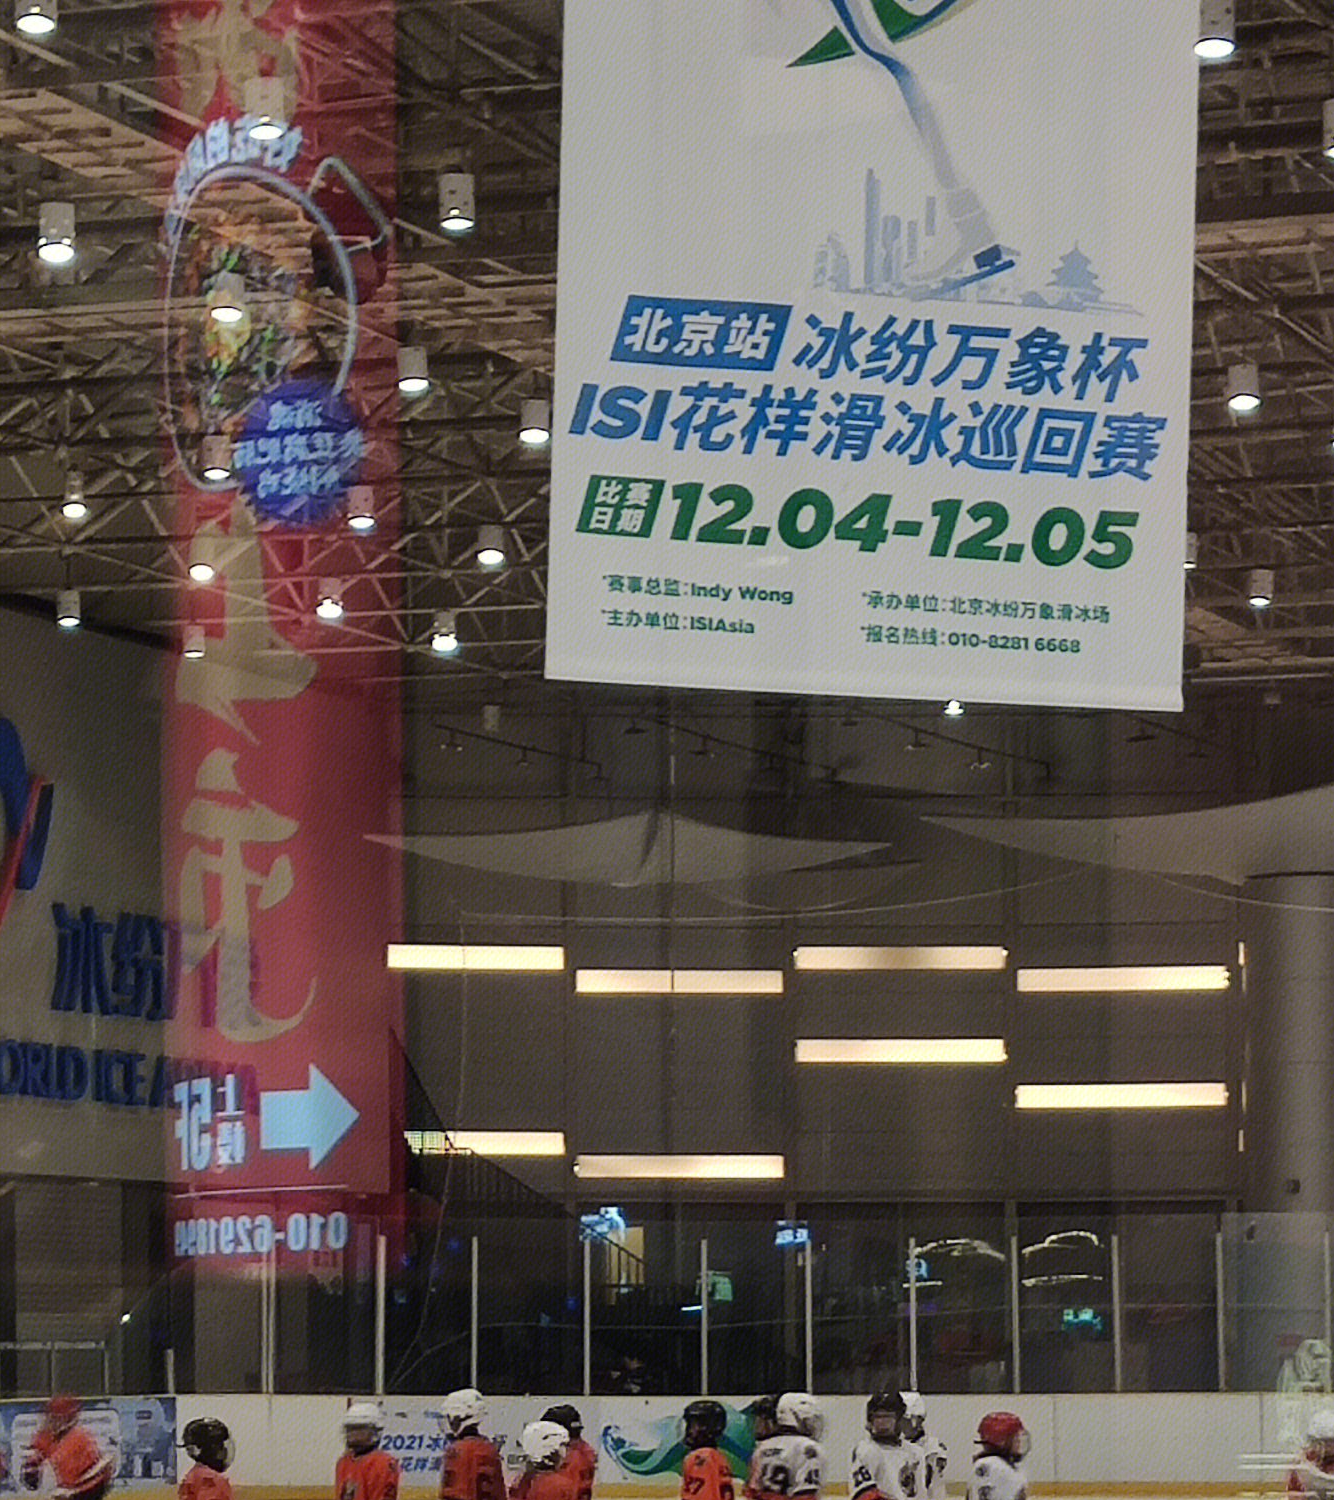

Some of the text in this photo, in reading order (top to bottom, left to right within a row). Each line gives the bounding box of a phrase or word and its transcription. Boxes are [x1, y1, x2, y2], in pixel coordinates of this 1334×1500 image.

[623, 307, 1149, 403] 北京站 冰纷万象杯
[568, 381, 1167, 481] ISI花样滑冰巡回赛
[595, 479, 654, 507] 比赛
[588, 506, 646, 533] 日期
[670, 482, 1139, 569] 12.04-12.05
[738, 585, 794, 605] Wong
[1034, 637, 1081, 653] 6668
[91, 1048, 147, 1106] ICE
